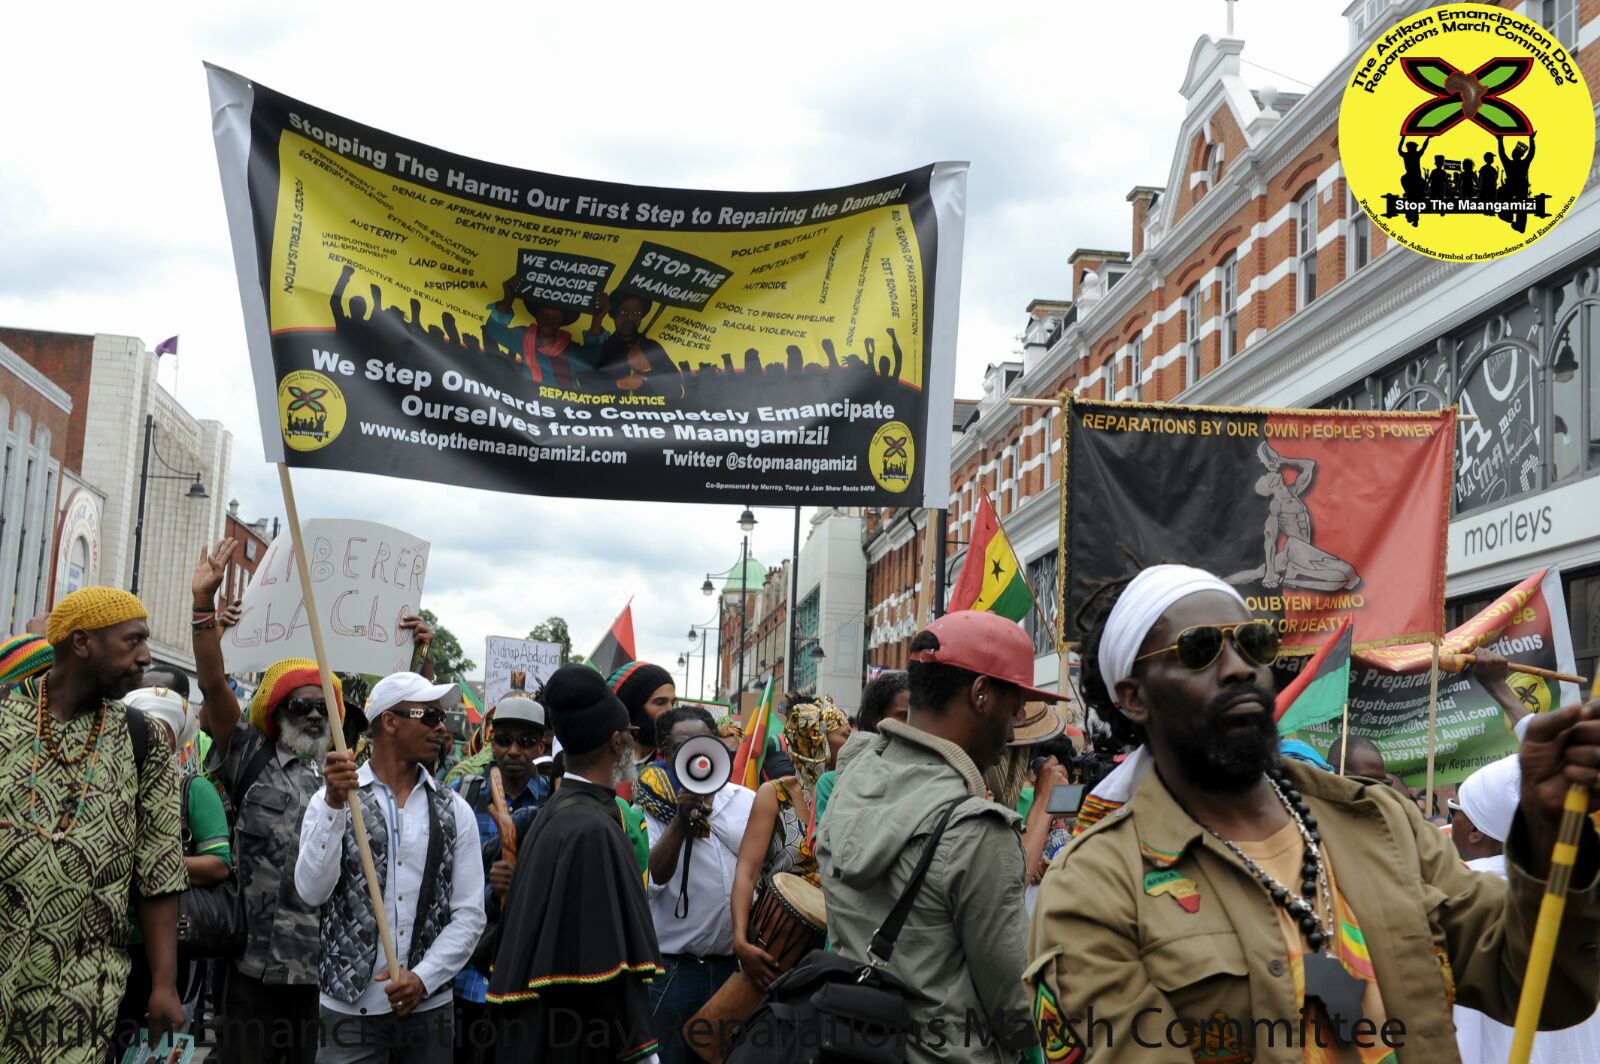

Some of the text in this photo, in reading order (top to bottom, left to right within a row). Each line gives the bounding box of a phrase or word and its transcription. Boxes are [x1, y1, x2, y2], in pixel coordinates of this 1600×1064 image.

[288, 112, 907, 229] Stopping The Harm: Our First Step to Repairing the Damage!
[298, 150, 394, 211] SOVEREIGN PEOPLEHOOD
[311, 148, 388, 198] DISMEMBERMENT OF
[392, 184, 428, 203] DENIAL
[430, 198, 445, 207] OF
[445, 203, 492, 220] AFRIKAN
[582, 232, 620, 244] RIGHTS
[284, 176, 304, 294] FORCED STERILISATION
[322, 232, 398, 256] UNEMPLOYMENT AND
[350, 218, 408, 244] AUSTERITY
[386, 214, 472, 266] EXTRACTIVE INDUSTRIES
[414, 220, 480, 258] MIS-EDUCATION
[455, 217, 560, 247] DEATHS IN CUSTODY
[730, 227, 830, 258] POLICE BRUTALITY
[895, 226, 912, 254] WEAPONS
[322, 240, 388, 260] MAL-EMPLOYMENT
[408, 257, 474, 276] LAND GRABS
[522, 253, 608, 278] WE CHARGE
[642, 252, 726, 288] STOP THE
[906, 265, 918, 284] MASS
[328, 252, 484, 322] REPRODUCTIVE AND SEXUAL VIOLENCE
[424, 280, 488, 291] AFRIPHOBIA
[526, 272, 598, 292] GENOCIDE
[744, 282, 787, 291] NUTRICIDE
[532, 288, 592, 306] ECOCIDE
[909, 284, 919, 336] DESTRUCTION
[671, 315, 716, 334] EXPANDING
[715, 300, 836, 323] SCHOOL TO PRISON PIPELINE
[658, 332, 710, 350] COMPLEXES
[722, 320, 808, 338] RACIAL VIOLENCE
[312, 348, 356, 376] We
[364, 358, 432, 392] Step
[442, 370, 556, 418] Onwards
[563, 406, 592, 420] to
[600, 406, 750, 424] Completely
[756, 398, 895, 422] Emancipate
[538, 386, 666, 406] REPARATORY JUSTICE
[401, 394, 830, 448] Ourselves from the Maangamizi!
[1082, 414, 1435, 440] REPARATIONS BY OUR OWN PEOPLE'S POWER
[360, 421, 858, 475] www.stopthemaangamizi.com Twitter @stopmaangamizi
[705, 482, 750, 490] Co-Sponsored
[751, 483, 760, 491] by
[1464, 506, 1552, 557] morleys
[1315, 594, 1364, 610] LANMO
[1278, 618, 1298, 634] OR
[1442, 722, 1486, 742] August
